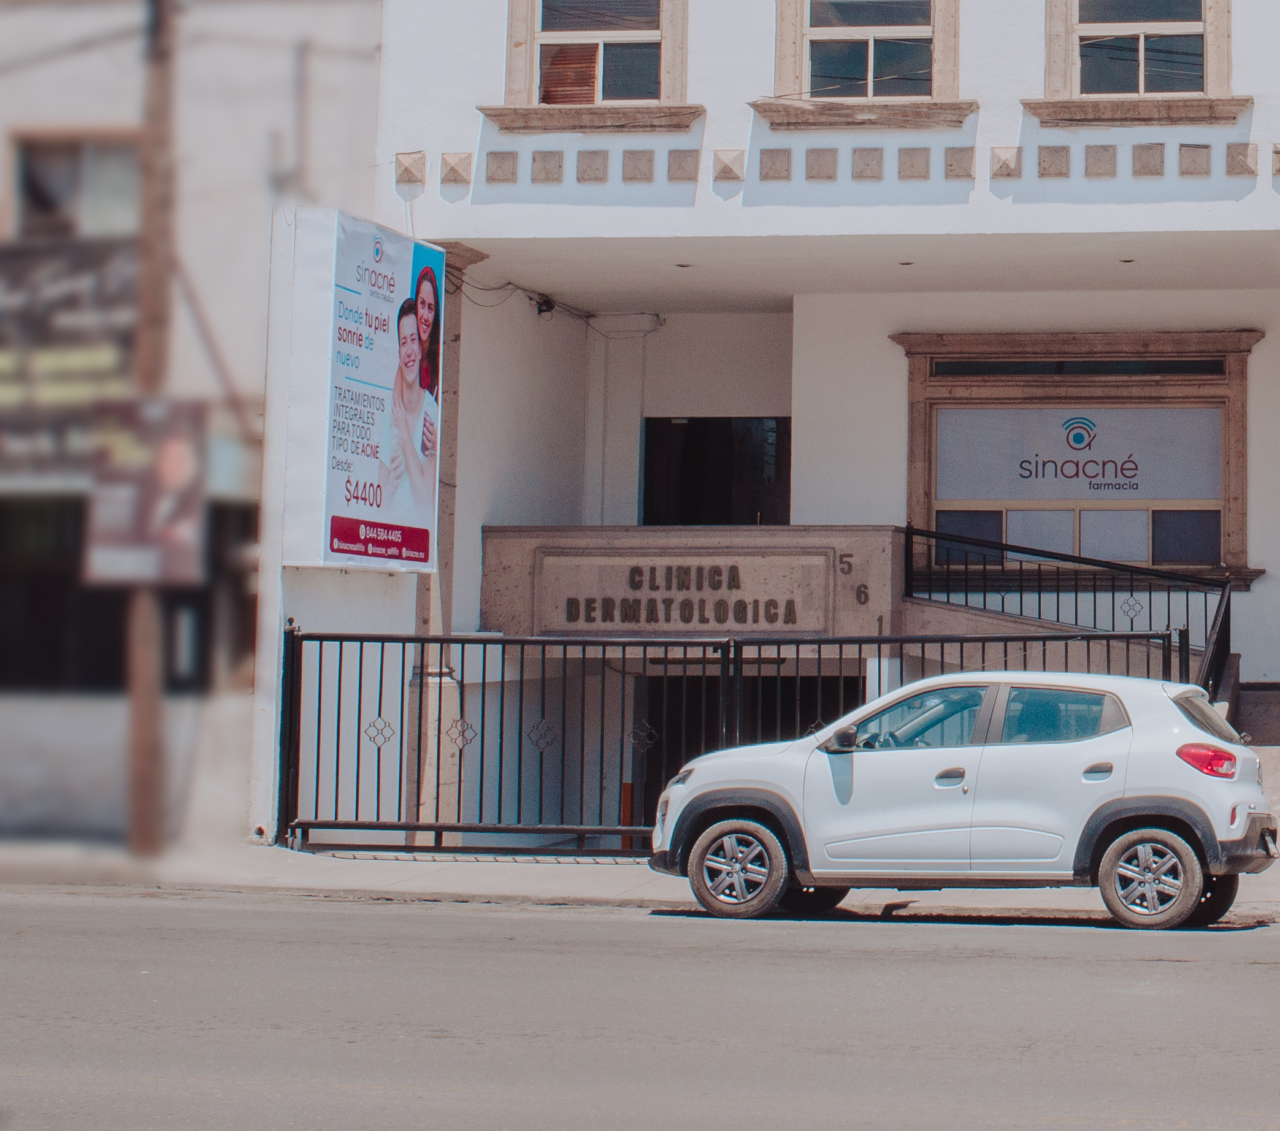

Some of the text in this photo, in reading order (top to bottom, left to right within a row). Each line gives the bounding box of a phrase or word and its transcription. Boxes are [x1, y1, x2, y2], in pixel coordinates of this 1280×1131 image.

[356, 261, 396, 294] sinacné
[338, 300, 390, 335] Donde tu piel
[337, 326, 374, 351] sonríe de
[336, 350, 360, 369] nuevo
[334, 385, 385, 412] TRATAMIENTOS
[333, 403, 375, 426] INTEGRALES
[332, 419, 371, 441] PARA TODO
[332, 435, 380, 460] TIPO DE ACNÉ
[332, 455, 353, 473] Desde:
[1019, 453, 1139, 479] sinacné
[345, 474, 383, 508] $4400
[1088, 480, 1139, 491] farmacia
[366, 526, 377, 539] 844
[377, 528, 387, 540] 584
[839, 553, 854, 575] 5
[628, 565, 742, 592] CLINICA
[855, 584, 870, 605] 6
[565, 597, 798, 625] DERMATOLOGICA
